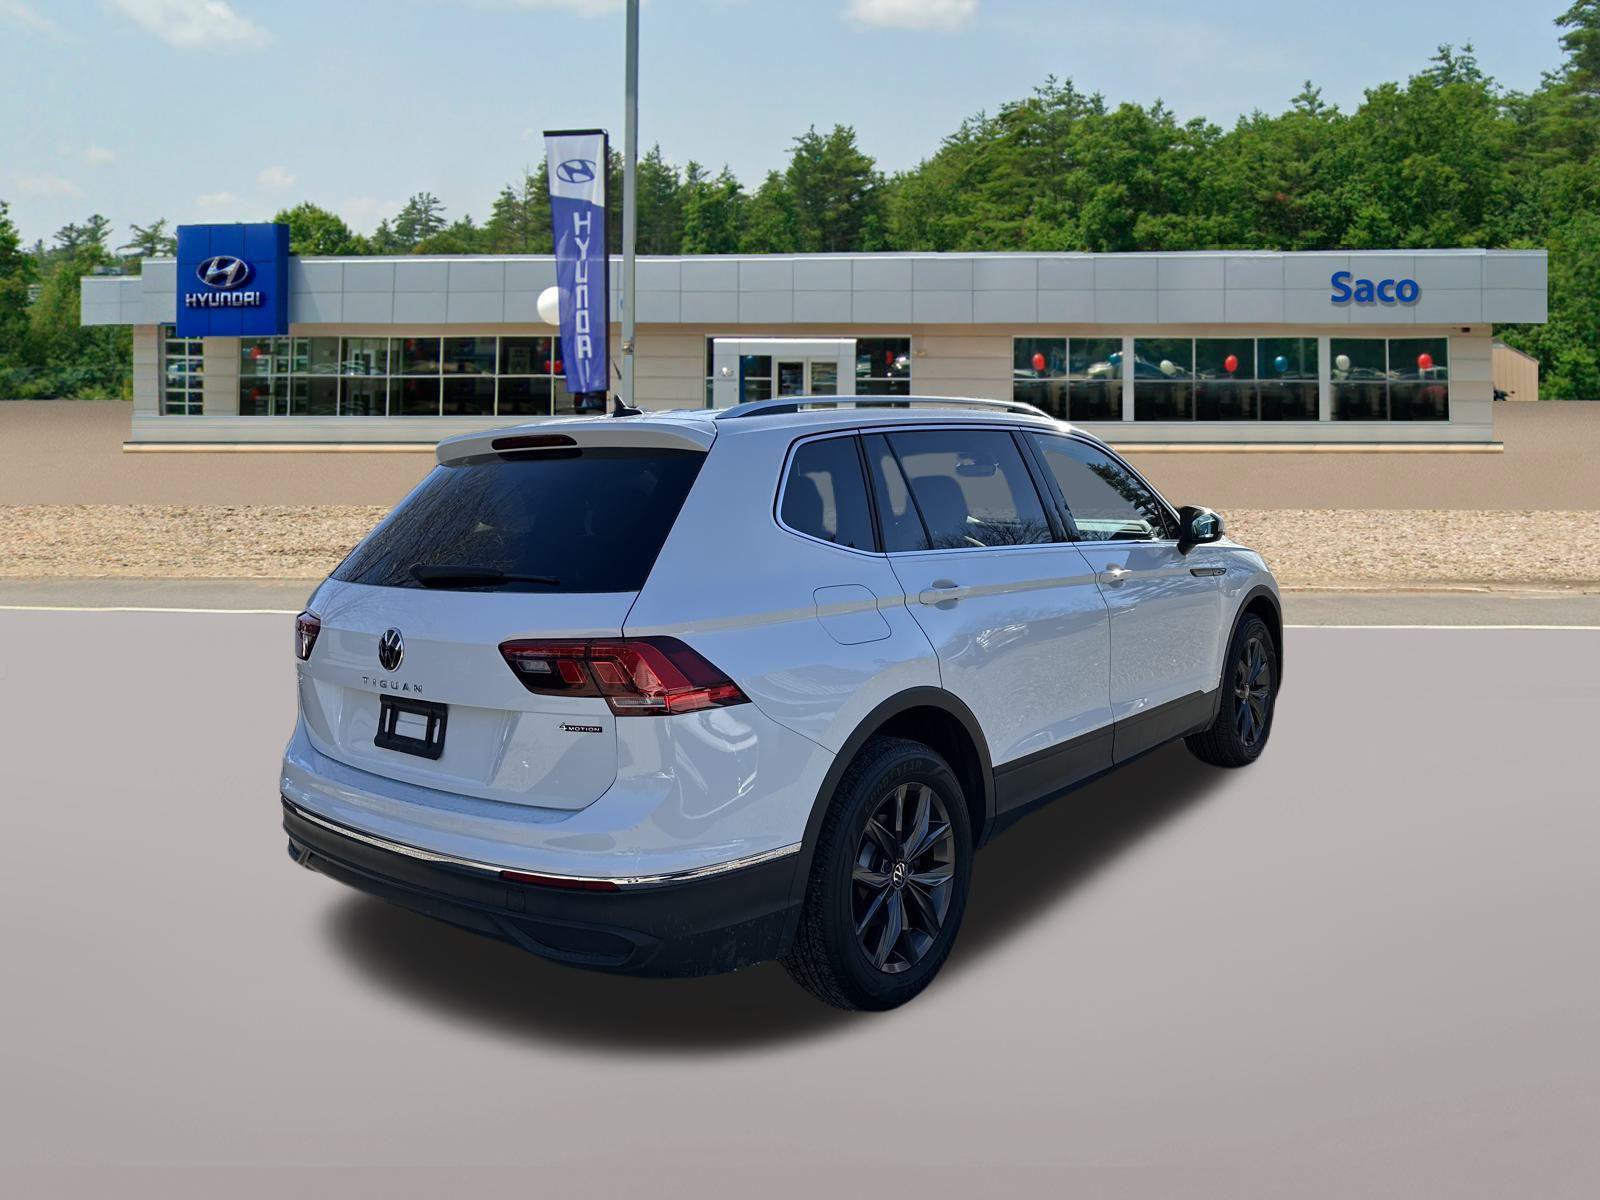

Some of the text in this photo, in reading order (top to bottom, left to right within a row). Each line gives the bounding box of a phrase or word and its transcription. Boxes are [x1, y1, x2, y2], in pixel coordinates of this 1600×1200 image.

[573, 211, 592, 382] HYUNDAI
[1330, 271, 1420, 306] Saco
[185, 291, 260, 307] HYUNDAI
[362, 676, 423, 694] TIGUAN
[559, 722, 602, 733] 4MOTION
